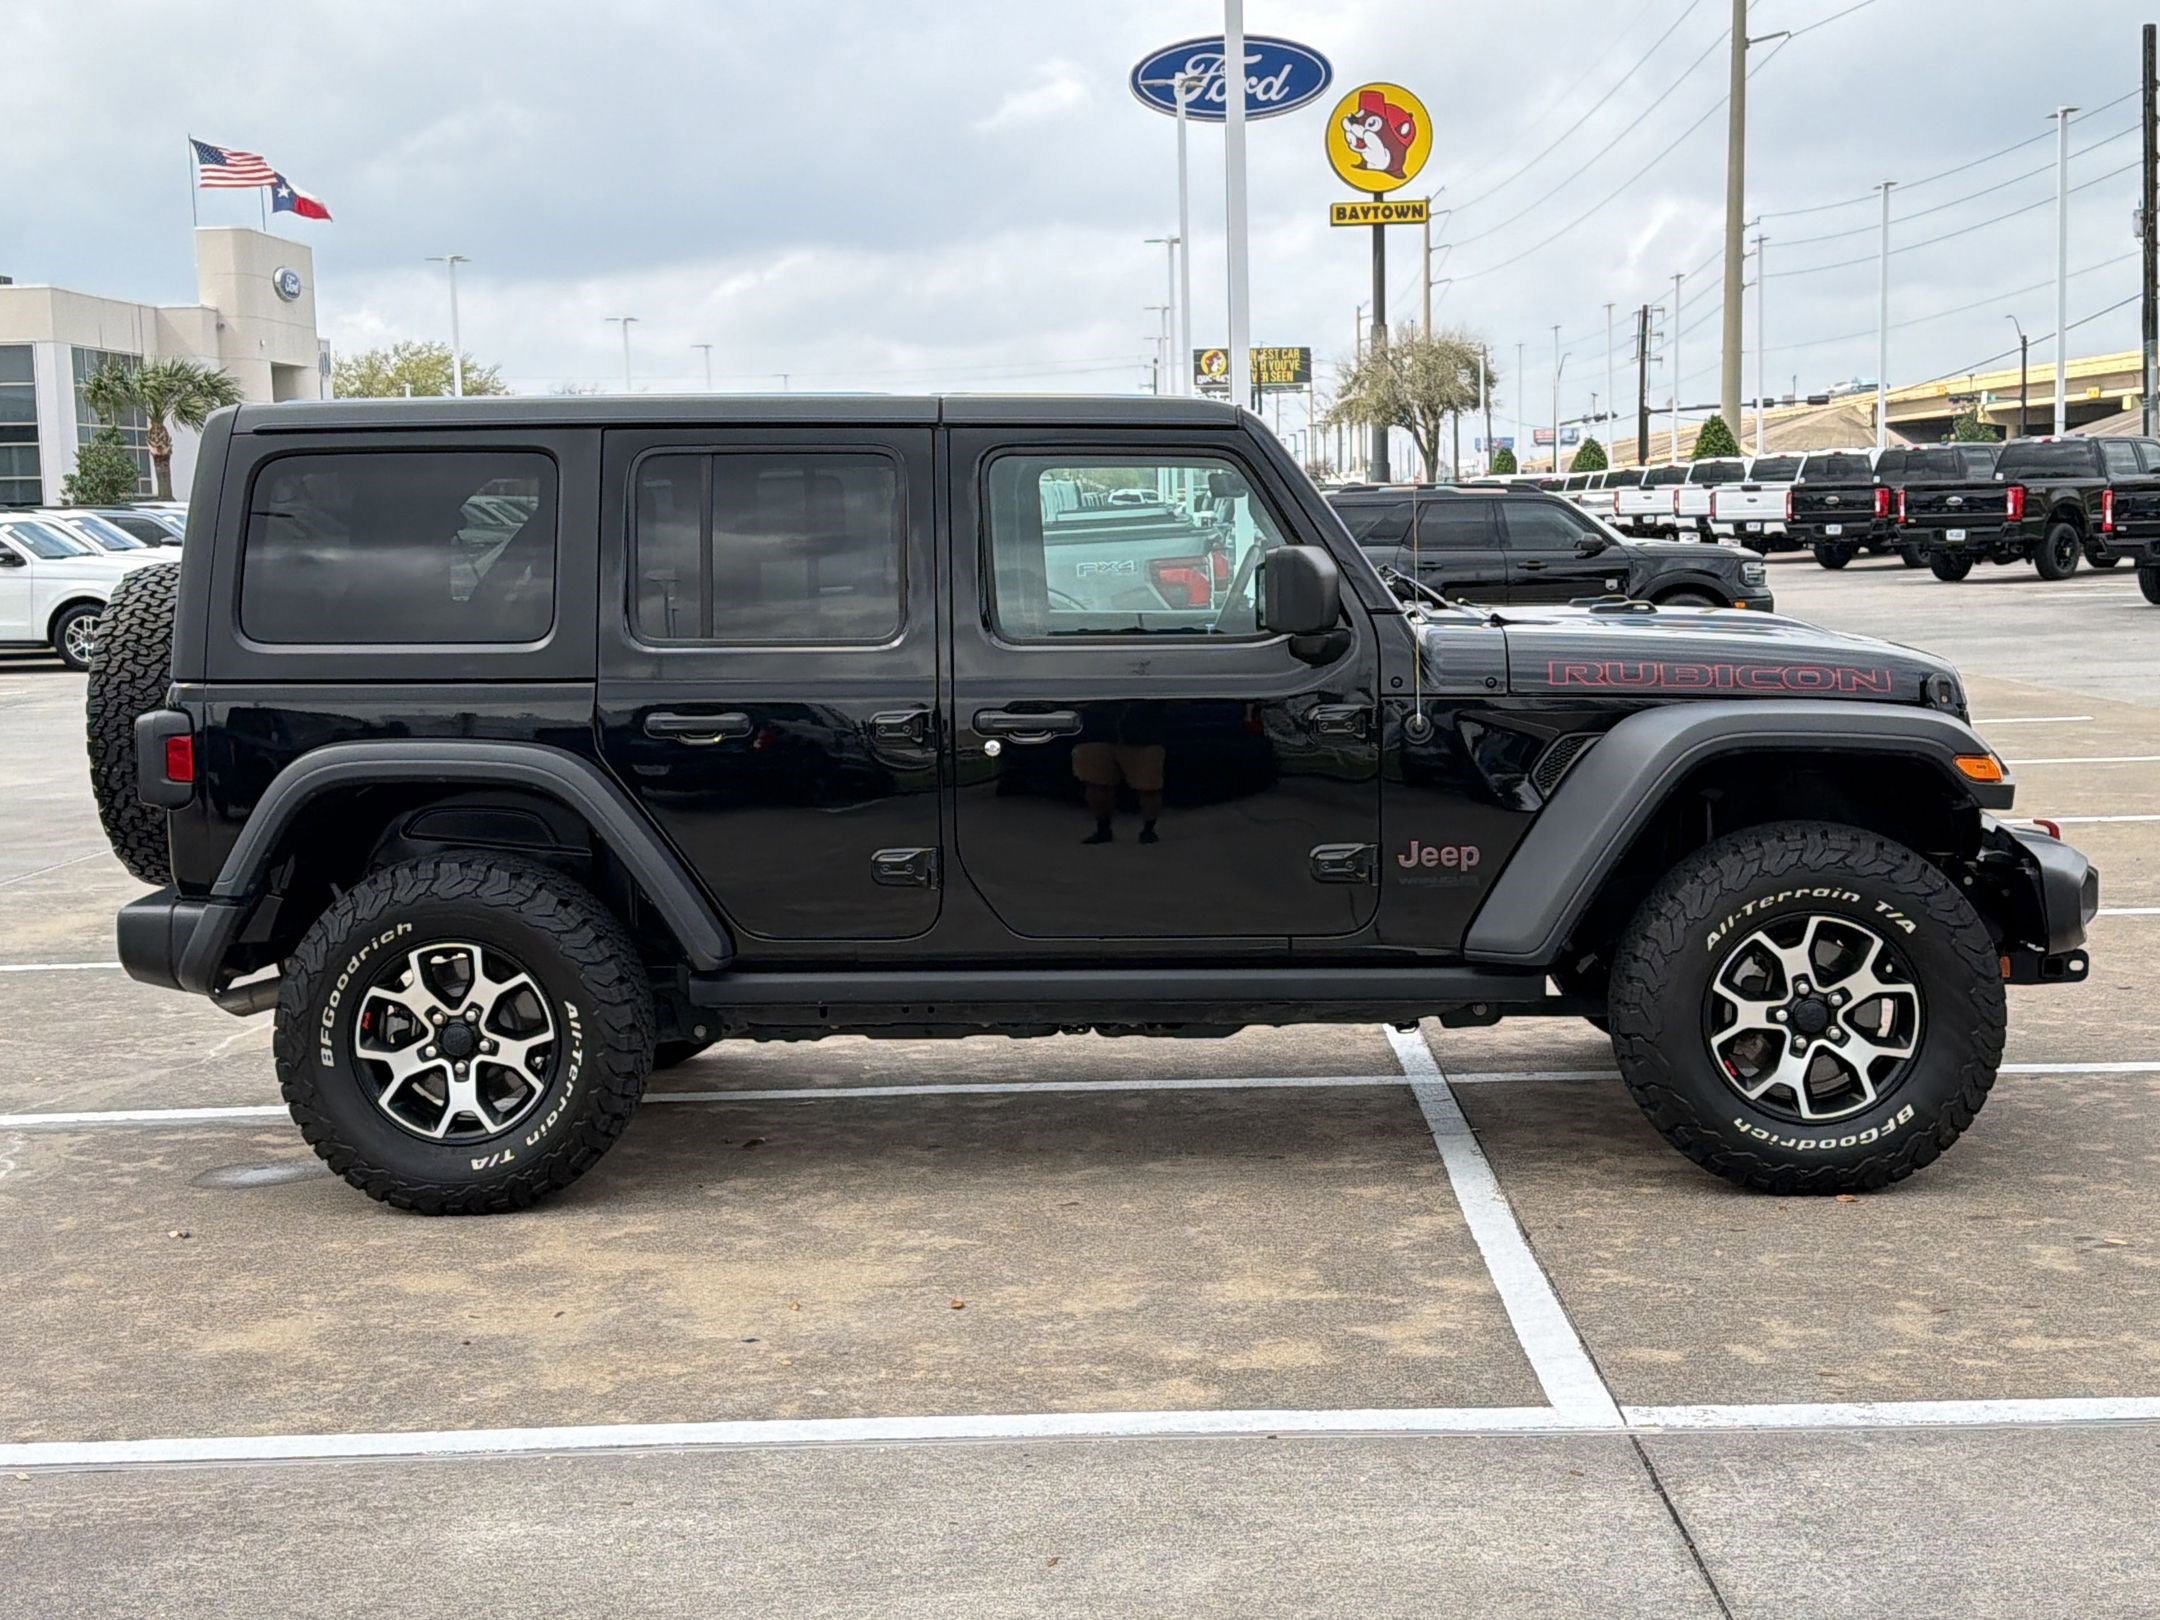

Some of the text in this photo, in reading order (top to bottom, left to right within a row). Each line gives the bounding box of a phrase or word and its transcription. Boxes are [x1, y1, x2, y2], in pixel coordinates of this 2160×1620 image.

[1336, 204, 1424, 220] BAYTOWN
[1282, 349, 1299, 359] CAR
[1271, 371, 1293, 382] SEEN
[1548, 661, 1892, 692] RUBICON
[1398, 841, 1480, 872] Jeep
[1874, 900, 1917, 935] T/A
[320, 922, 413, 1067] BFGoodrich
[1734, 1104, 1916, 1150] BFGoodrich
[471, 1148, 516, 1171] T/A
